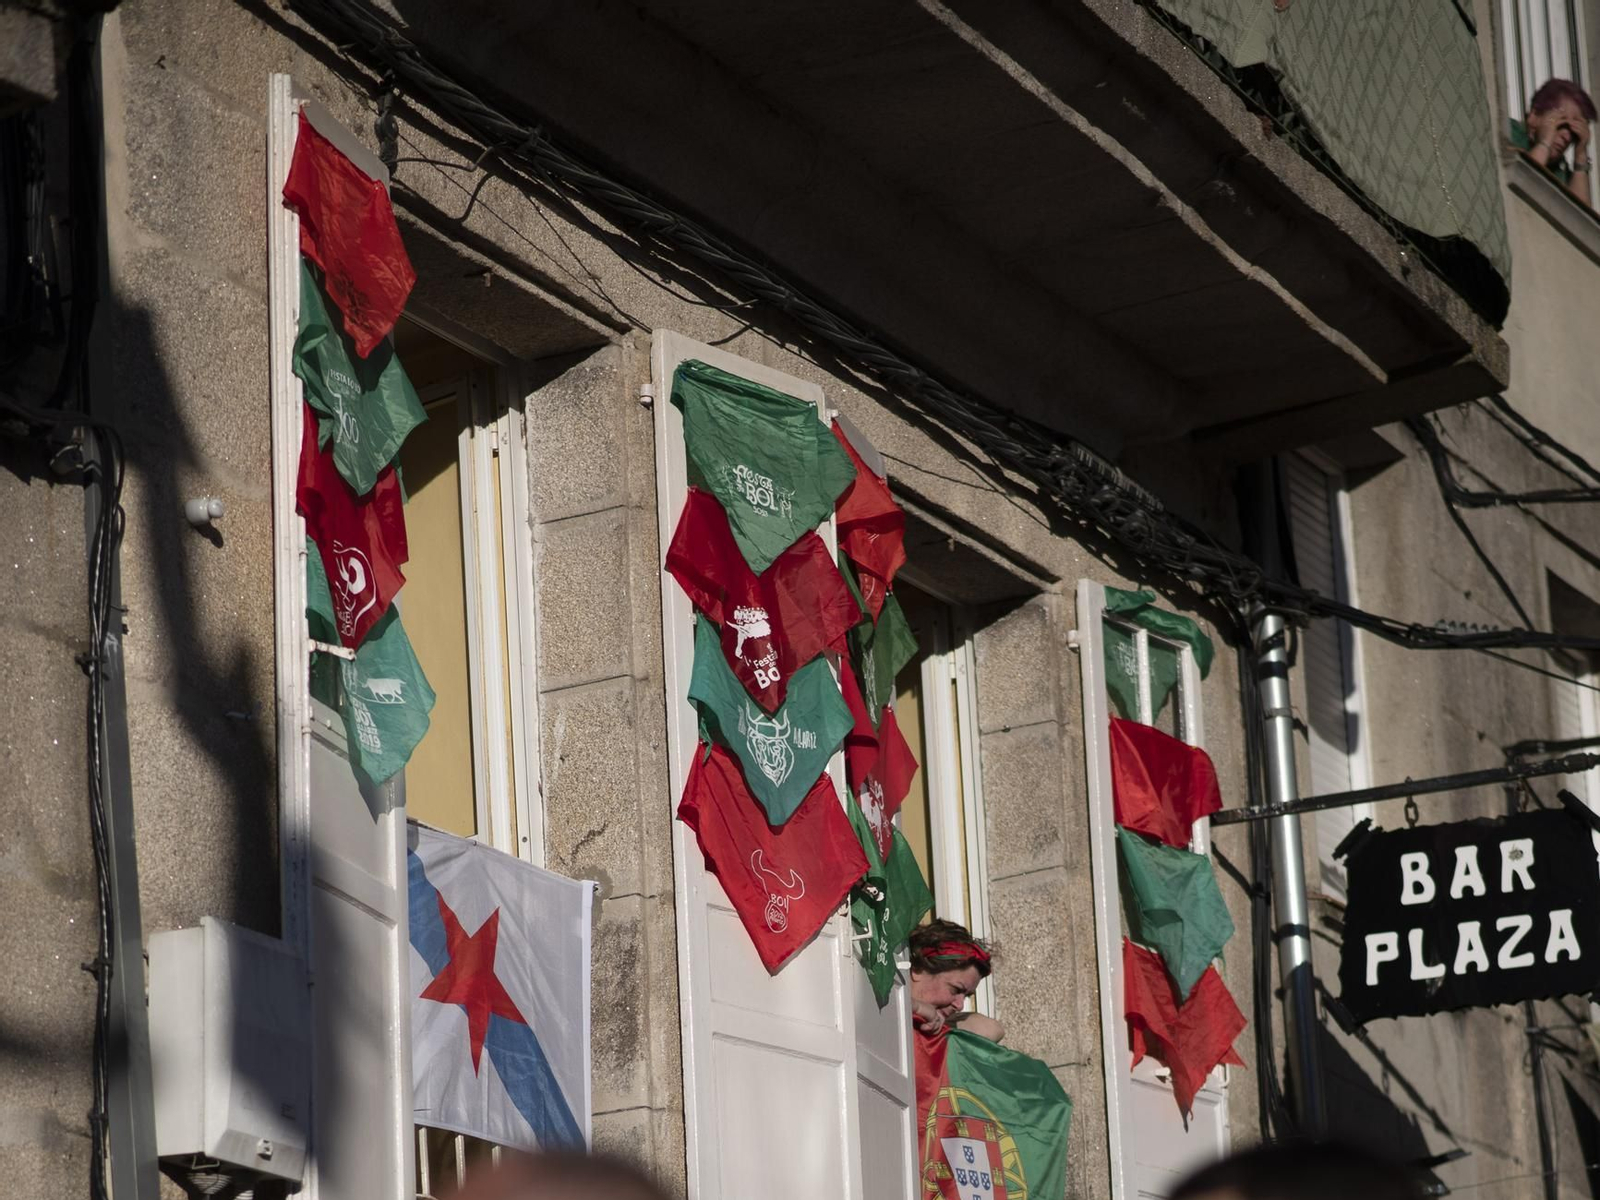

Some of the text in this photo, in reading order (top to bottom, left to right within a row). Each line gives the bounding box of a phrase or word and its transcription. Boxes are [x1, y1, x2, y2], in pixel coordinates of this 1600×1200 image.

[744, 481, 779, 511] BOI
[1400, 838, 1536, 906] BAR
[1364, 908, 1581, 986] PLAZA
